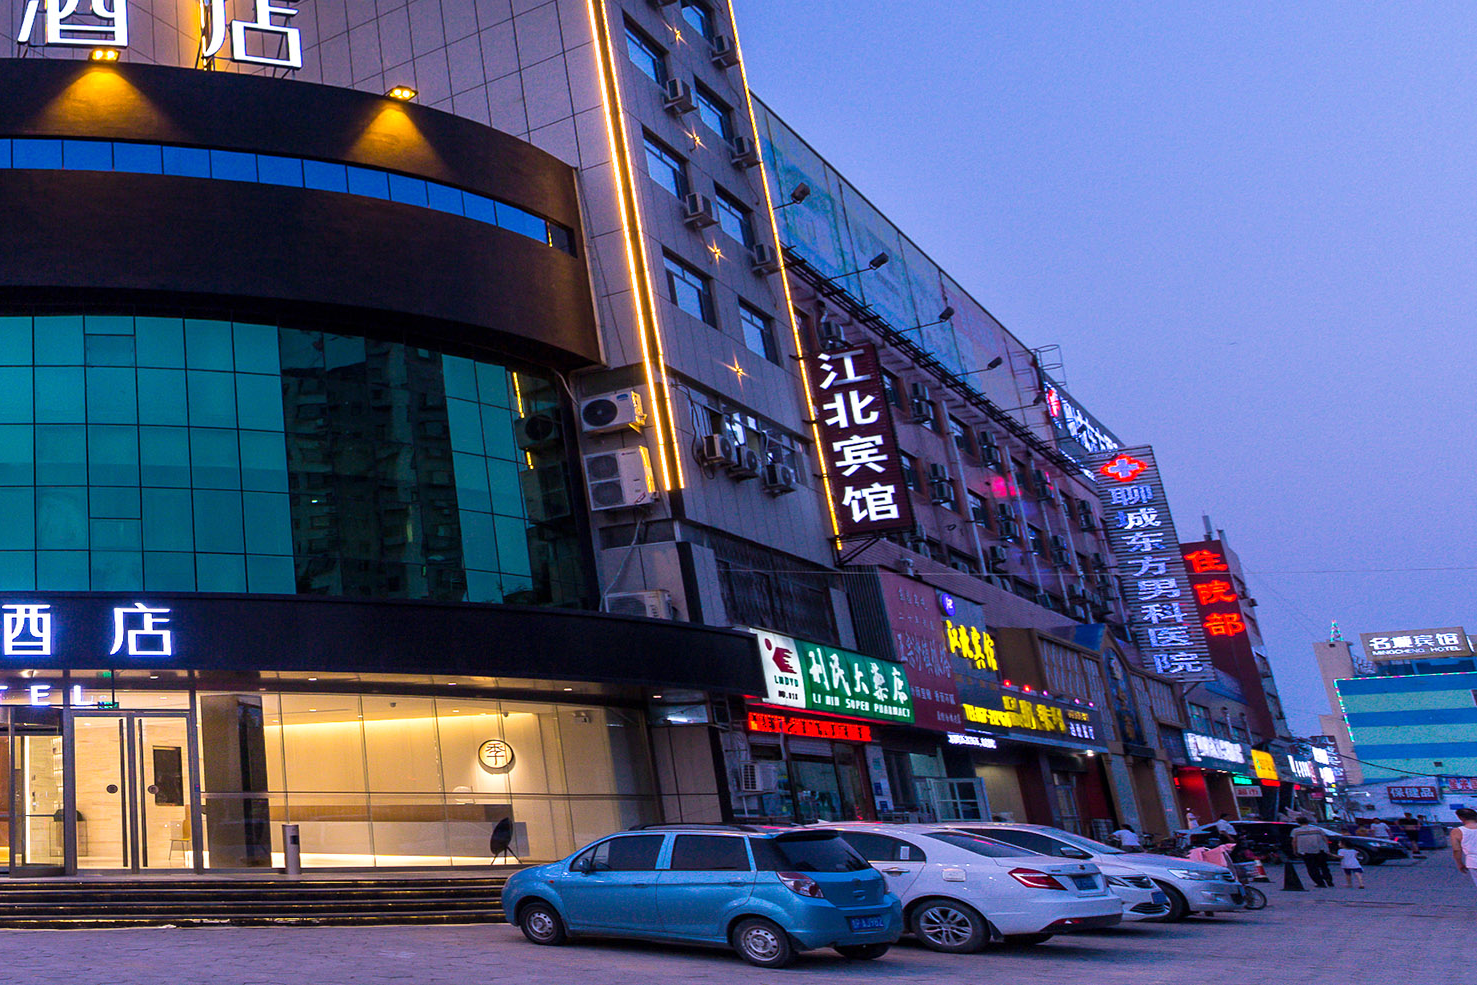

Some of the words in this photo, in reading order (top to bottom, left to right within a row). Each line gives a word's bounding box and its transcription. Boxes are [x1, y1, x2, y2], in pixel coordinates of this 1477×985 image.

[817, 349, 900, 523] 江北宾馆
[1108, 484, 1203, 674] 聊城东方男科医院
[1184, 549, 1246, 637] 住院部
[1430, 645, 1462, 653] HOTEL
[812, 692, 822, 704] LI
[845, 698, 870, 712] SUPER
[485, 742, 506, 766] 季
[1390, 787, 1435, 798] 保健品
